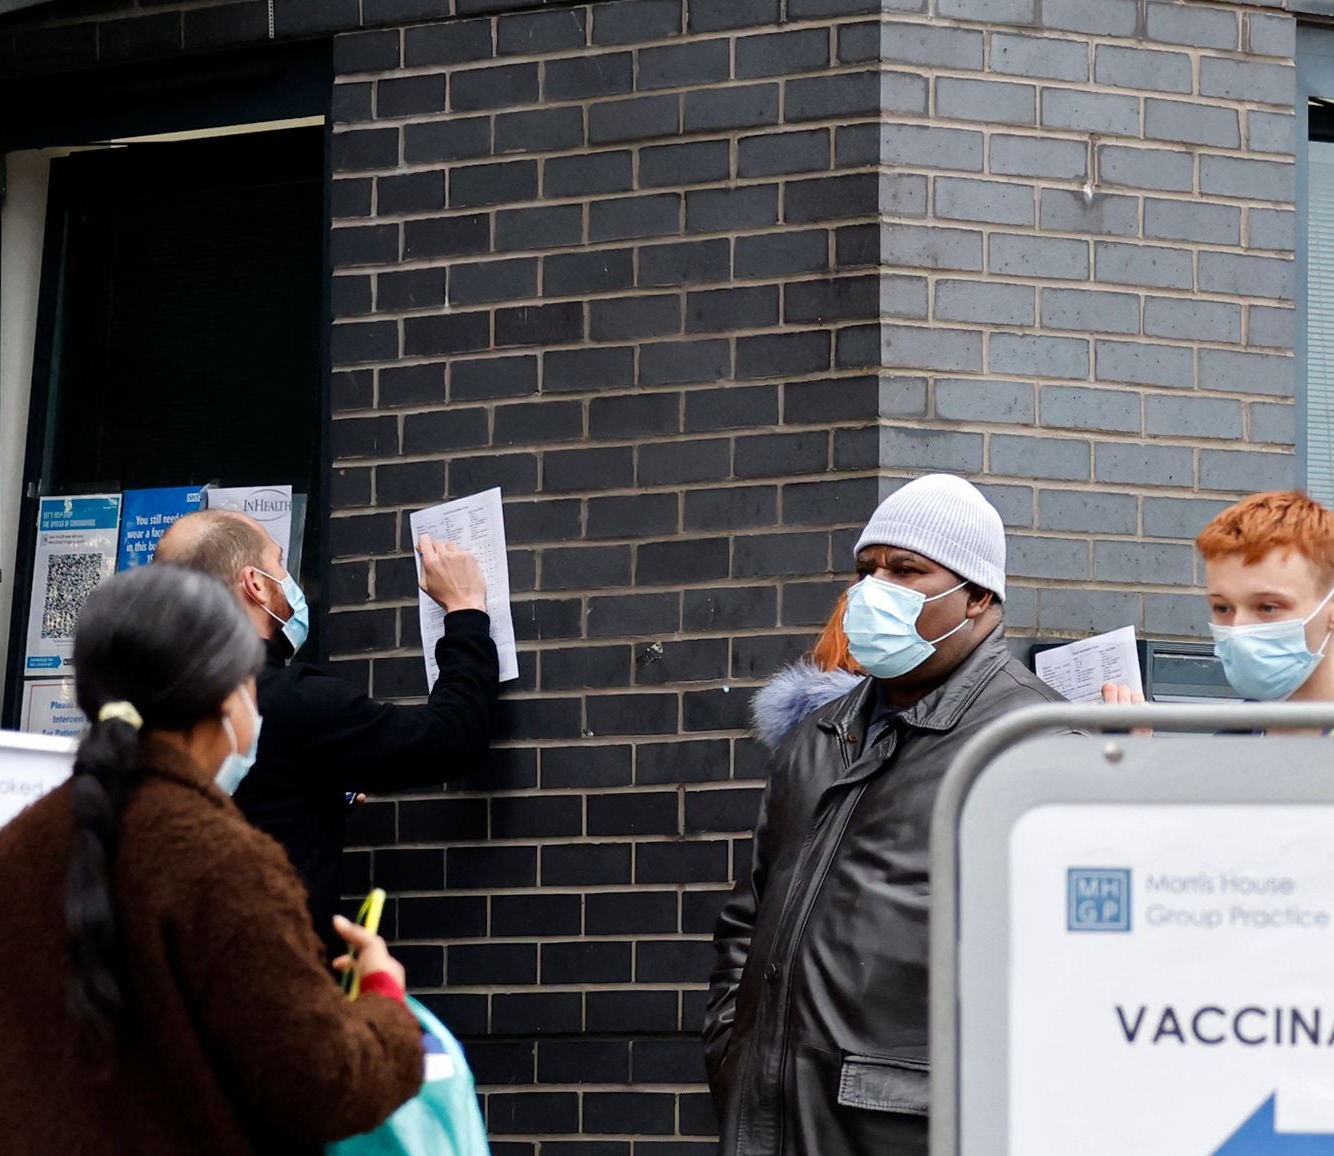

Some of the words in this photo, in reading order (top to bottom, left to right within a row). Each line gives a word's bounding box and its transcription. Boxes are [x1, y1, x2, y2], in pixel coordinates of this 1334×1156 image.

[136, 515, 149, 526] You
[149, 513, 163, 525] still
[127, 530, 144, 539] wear
[146, 530, 150, 538] a
[126, 544, 133, 552] in
[134, 541, 147, 552] this
[52, 716, 85, 724] Intercom
[1076, 877, 1119, 898] MH
[1143, 872, 1215, 896] Morris
[1218, 873, 1297, 897] House
[1077, 899, 1119, 924] GP
[1143, 902, 1224, 930] Group
[1228, 904, 1332, 929] Practice
